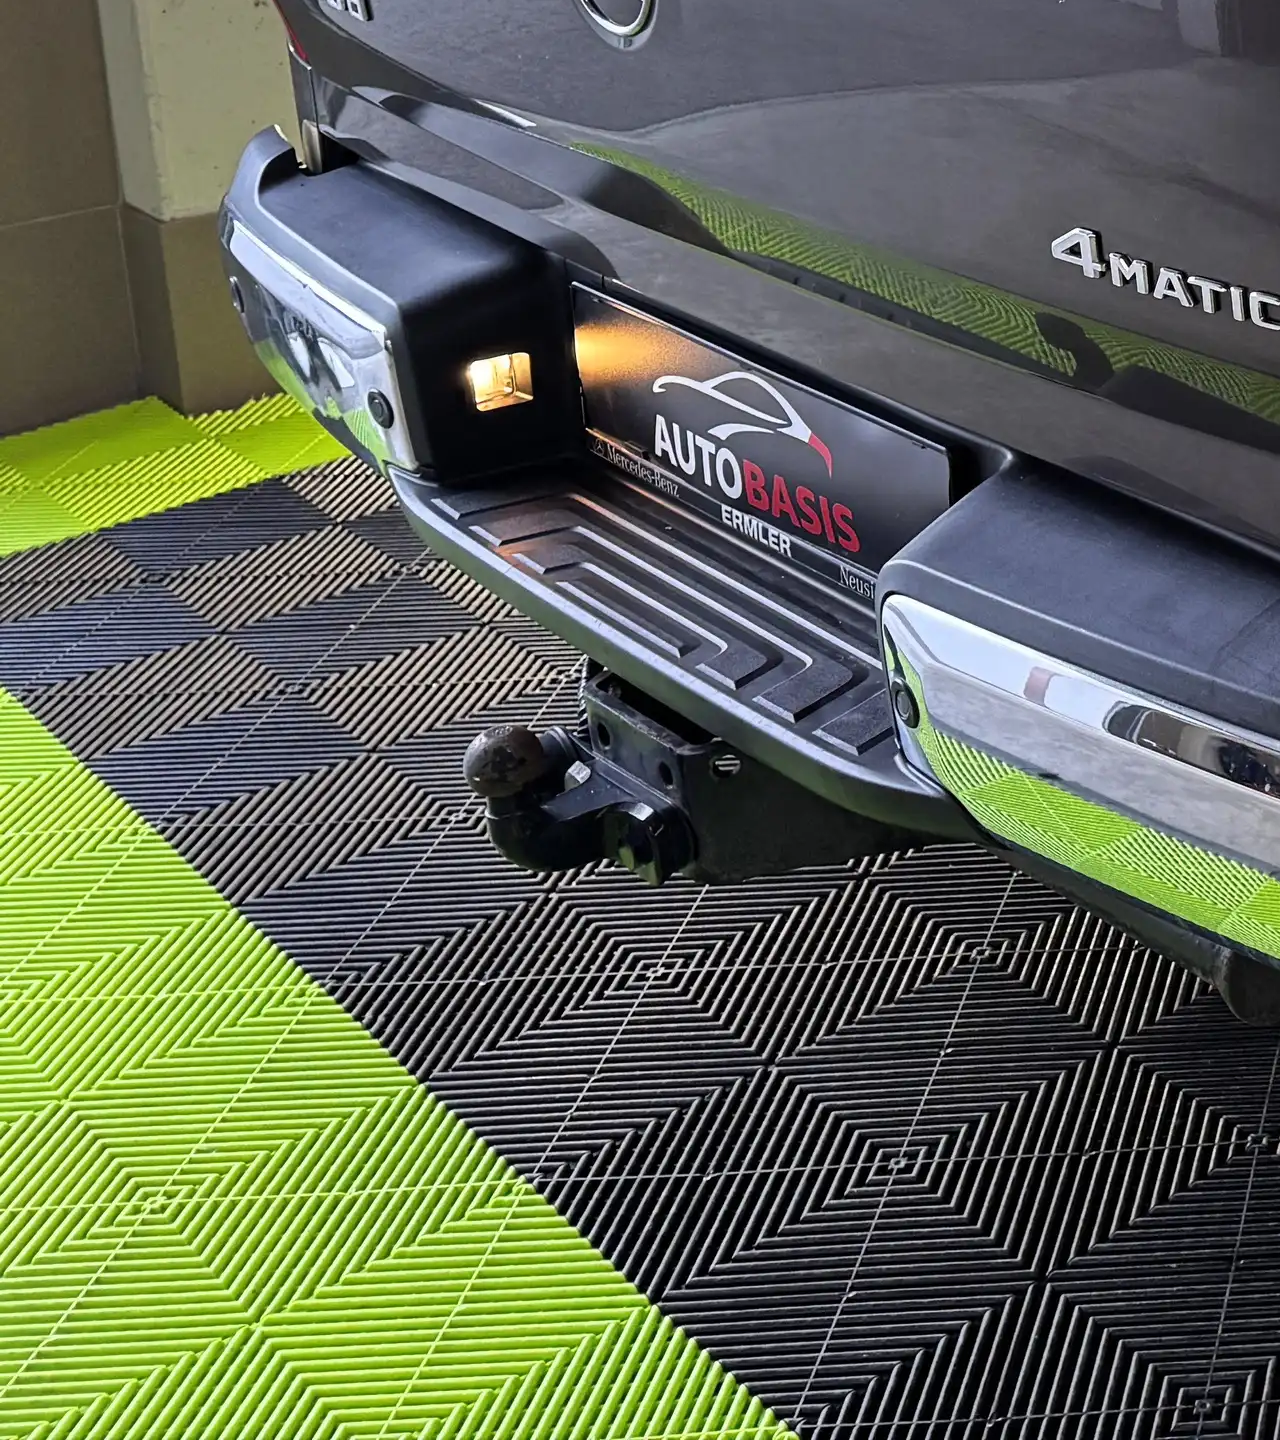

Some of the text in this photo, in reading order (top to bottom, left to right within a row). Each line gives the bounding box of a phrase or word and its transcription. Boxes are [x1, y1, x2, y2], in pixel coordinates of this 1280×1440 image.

[607, 442, 680, 498] Mercedes-Benz
[654, 414, 861, 553] AUTOBASIS
[720, 503, 792, 558] ERMLER
